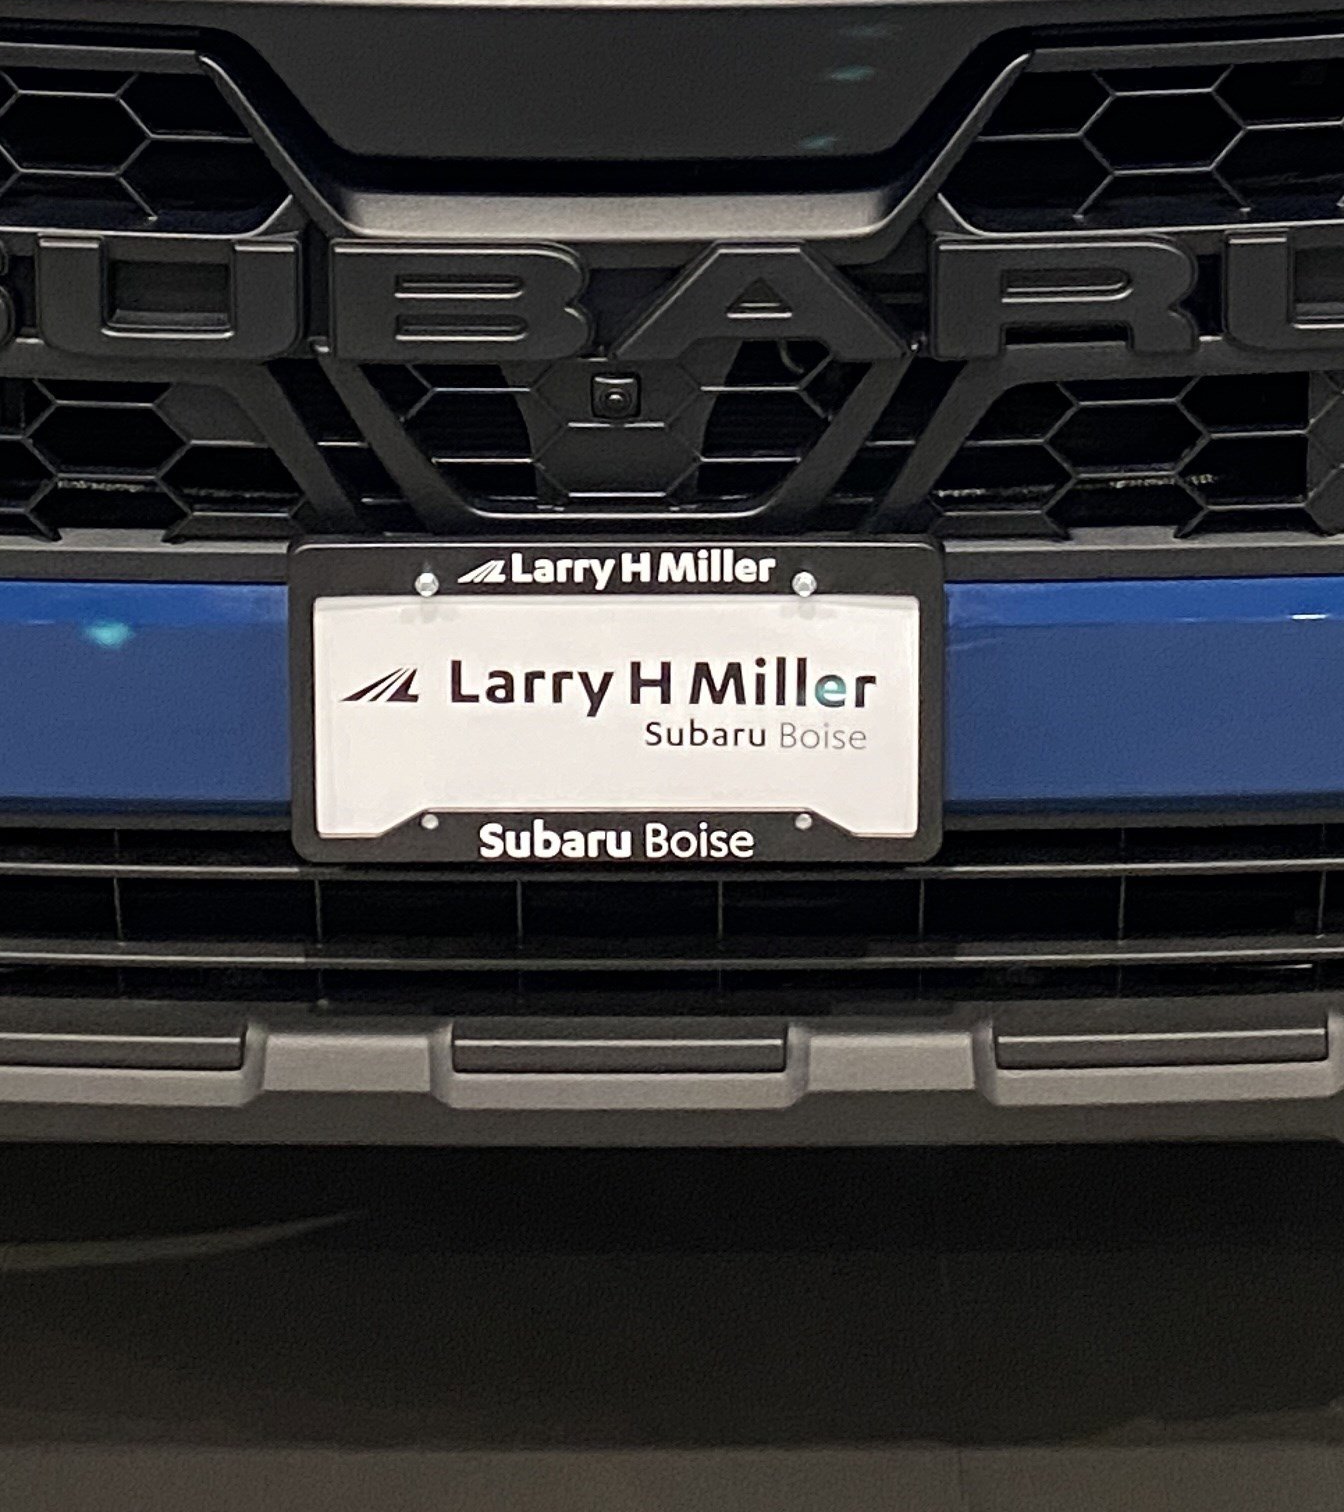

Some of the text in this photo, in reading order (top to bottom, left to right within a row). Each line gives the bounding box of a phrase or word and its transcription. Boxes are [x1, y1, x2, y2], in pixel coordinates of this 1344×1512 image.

[510, 549, 775, 591] Larry H Miller
[449, 657, 877, 718] Larry H Miller
[644, 719, 868, 751] Subaru Boise
[479, 820, 755, 859] Subaru Boise
